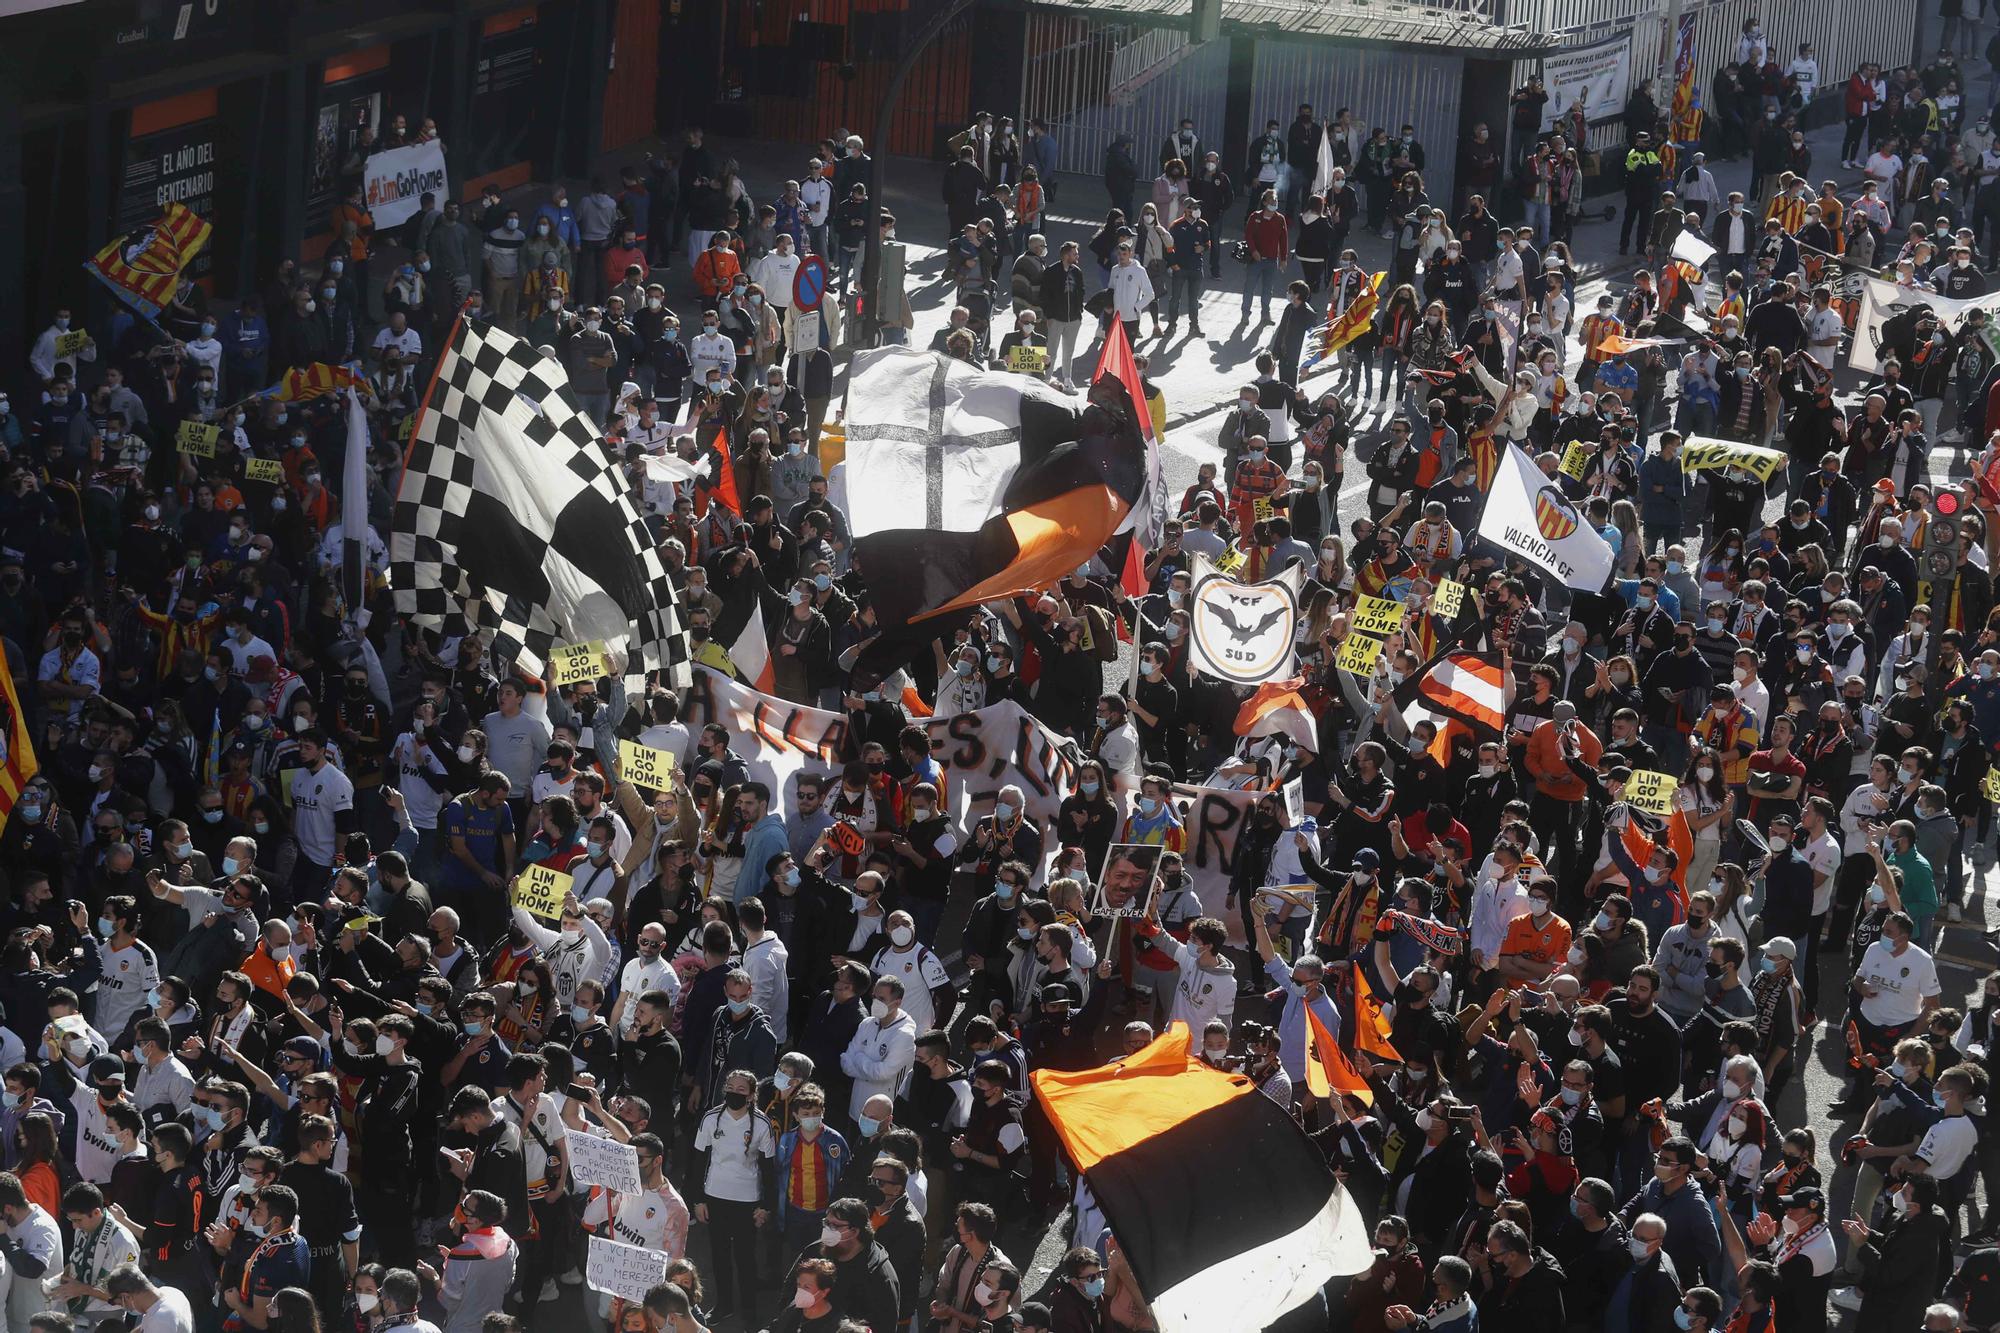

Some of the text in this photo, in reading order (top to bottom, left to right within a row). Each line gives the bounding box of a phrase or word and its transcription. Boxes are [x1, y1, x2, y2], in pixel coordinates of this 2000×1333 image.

[163, 154, 174, 175] EL
[176, 145, 194, 172] AÑO
[197, 142, 214, 169] DEL
[157, 172, 213, 207] CENTENARIO
[367, 168, 443, 206] #LimGoHome
[1012, 362, 1040, 370] HOME
[1020, 355, 1033, 363] GO
[189, 424, 207, 435] LIM
[189, 434, 203, 443] GO
[182, 443, 210, 455] HOME
[254, 460, 274, 469] LIM
[1566, 446, 1581, 475] LIM G
[247, 472, 276, 482] HOME
[1504, 526, 1574, 579] VALENCIA CF
[1446, 583, 1465, 596] LIM
[1367, 599, 1397, 612] LIM
[1370, 610, 1386, 618] GO
[1353, 616, 1398, 632] HOME
[565, 645, 589, 657] LIM
[1348, 636, 1373, 652] LIM
[1225, 648, 1256, 662] SUD
[1351, 649, 1364, 659] GO
[569, 656, 589, 668] GO
[1338, 656, 1374, 675] HOME
[561, 665, 600, 682] HOME
[633, 747, 656, 762] LIM
[634, 760, 654, 772] GO
[624, 767, 663, 787] HOME
[1637, 773, 1662, 787] LIM
[1637, 785, 1657, 797] GO
[1625, 794, 1665, 811] HOME
[531, 867, 556, 886] LIM
[530, 882, 550, 897] GO
[516, 891, 556, 914] HOME
[1092, 908, 1145, 918] GAME OVER
[569, 1133, 635, 1157] HABEIS ACABADO
[573, 1146, 636, 1167] CON NUESTRA
[588, 1158, 630, 1176] PACIENCIA
[573, 1164, 642, 1195] GAME OVER
[613, 1217, 645, 1246] bwin
[590, 1239, 603, 1251] EL
[610, 1241, 628, 1254] VCF
[604, 1254, 663, 1274] UN FUTURO
[591, 1262, 664, 1284] YO MEREZCO
[589, 1276, 612, 1290] VIVIR
[616, 1283, 634, 1295] ESE
